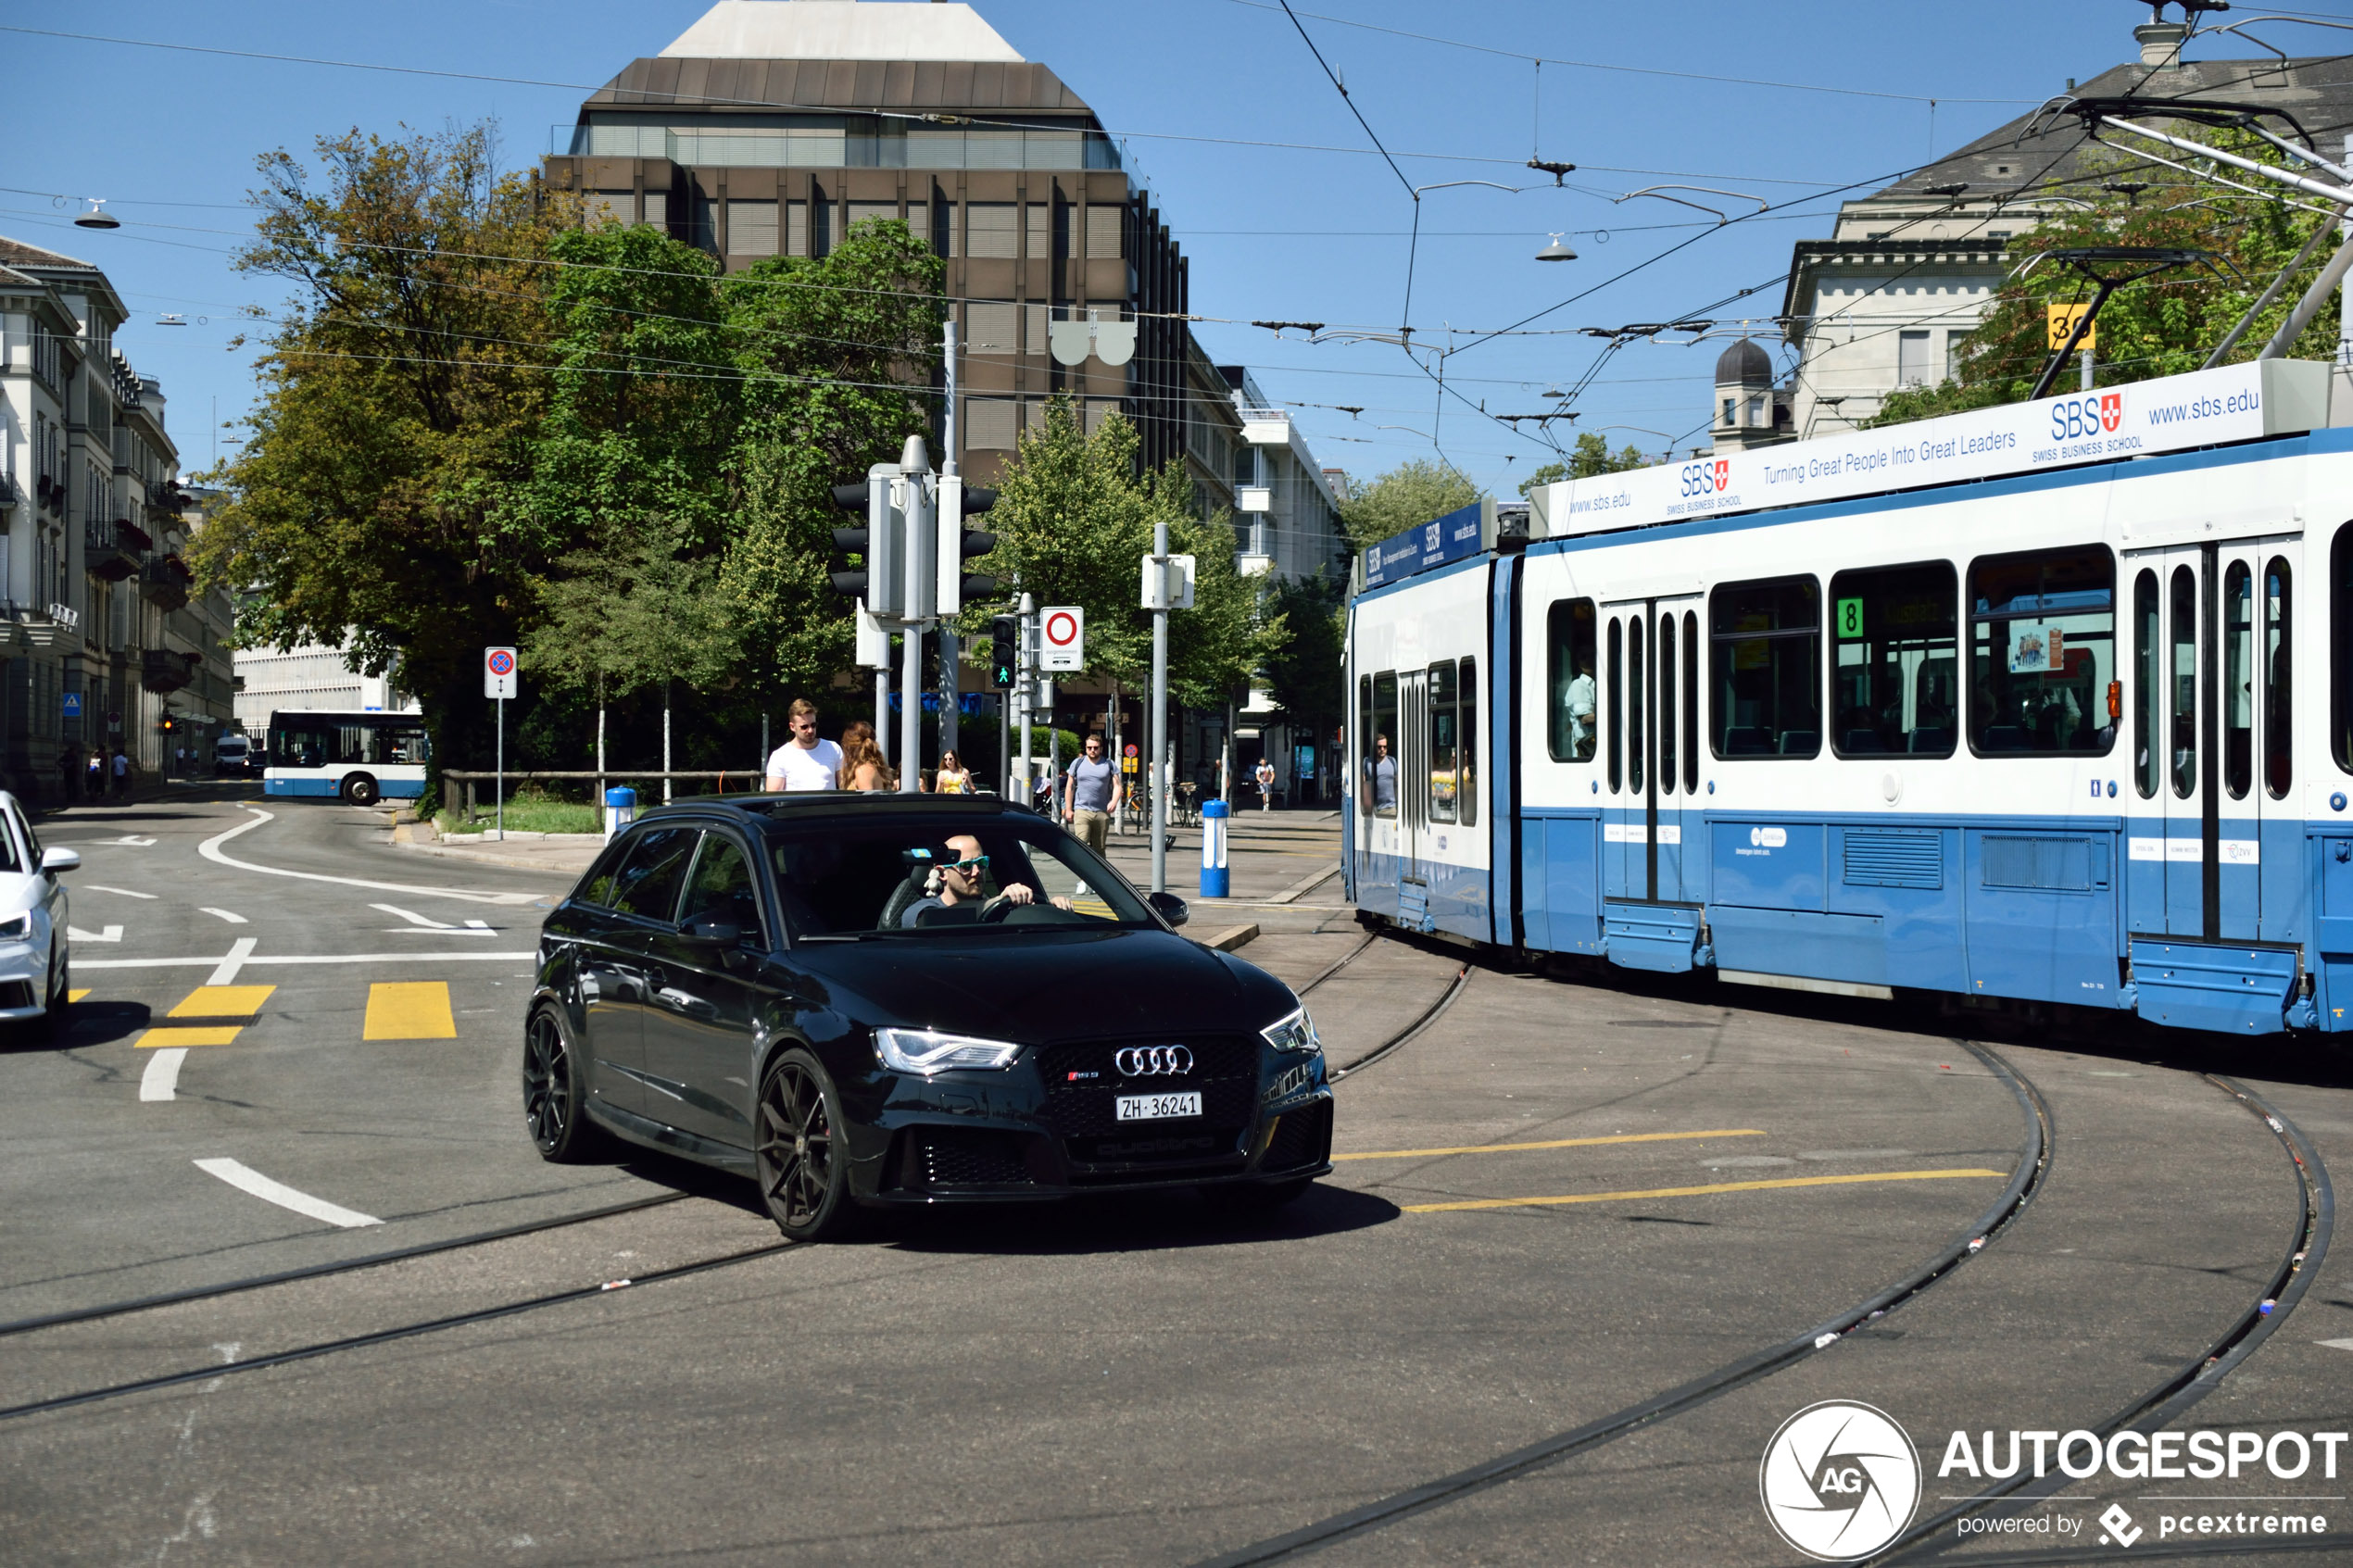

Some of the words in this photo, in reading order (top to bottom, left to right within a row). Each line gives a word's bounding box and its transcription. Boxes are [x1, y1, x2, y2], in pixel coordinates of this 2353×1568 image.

[2052, 397, 2100, 442] SBS
[2148, 388, 2260, 426] www.sbs.edu
[1764, 463, 1805, 484] Turning
[1808, 456, 1842, 478] Great
[1846, 448, 1887, 473] People
[1892, 445, 1915, 465] Into
[1919, 437, 1957, 461] Great
[1960, 431, 2017, 455] Leaders
[2032, 451, 2057, 463] SWISS
[2061, 441, 2103, 458] BUSINESS
[2107, 436, 2143, 452] SCHOOL
[1680, 462, 1714, 497] SBS
[1569, 490, 1631, 515] www.sbs.edu
[1667, 504, 1685, 516] SWISS
[1687, 499, 1715, 512] BUSINESS
[1718, 495, 1742, 508] SCHOOL
[1845, 602, 1857, 632] 8
